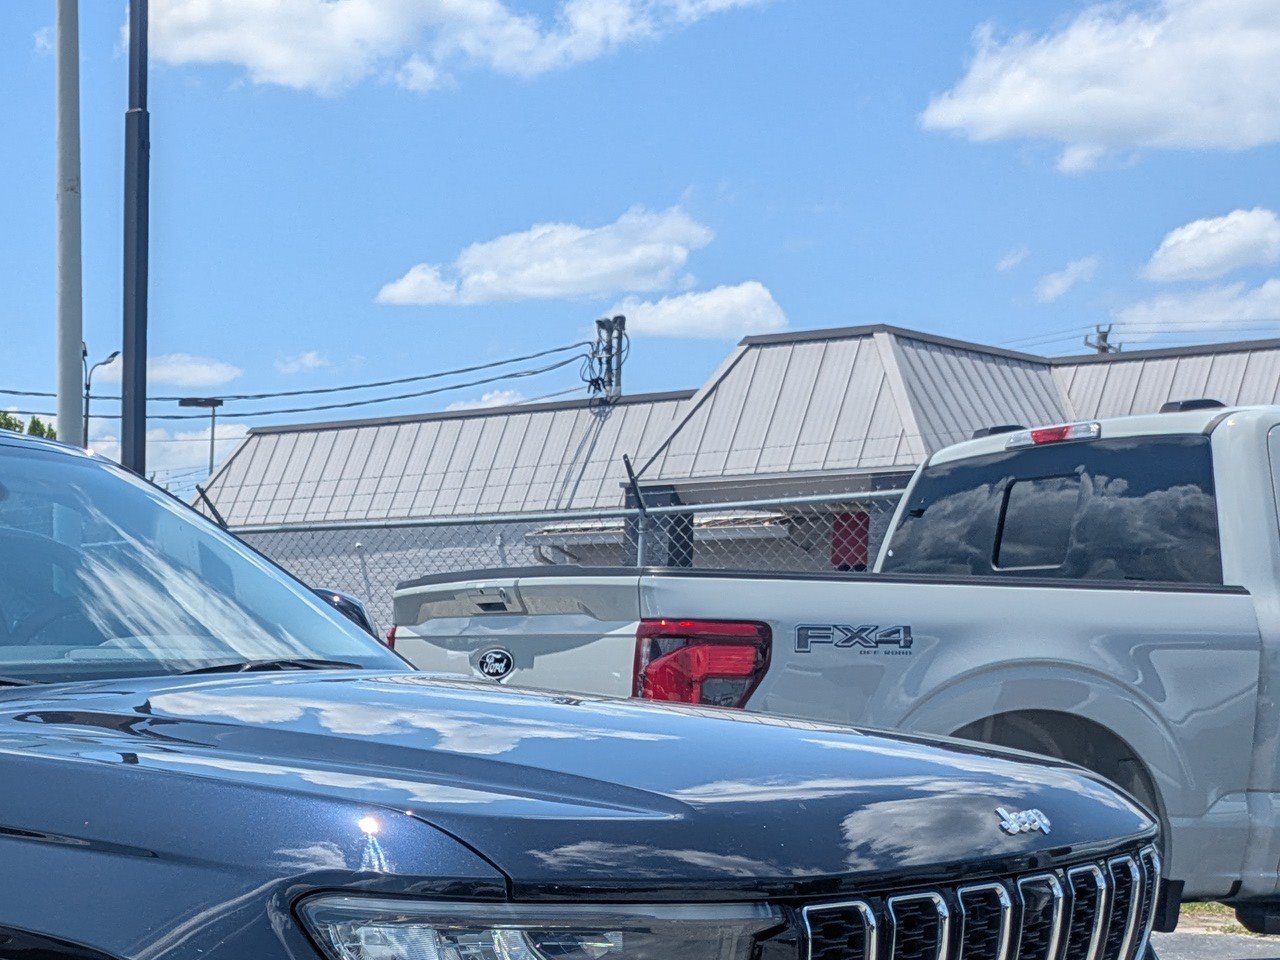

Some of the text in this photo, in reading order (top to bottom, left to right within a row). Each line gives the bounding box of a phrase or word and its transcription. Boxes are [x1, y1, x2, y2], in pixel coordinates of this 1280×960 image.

[794, 623, 913, 653] FX4
[483, 652, 507, 673] Ford
[994, 806, 1052, 836] Jeep
